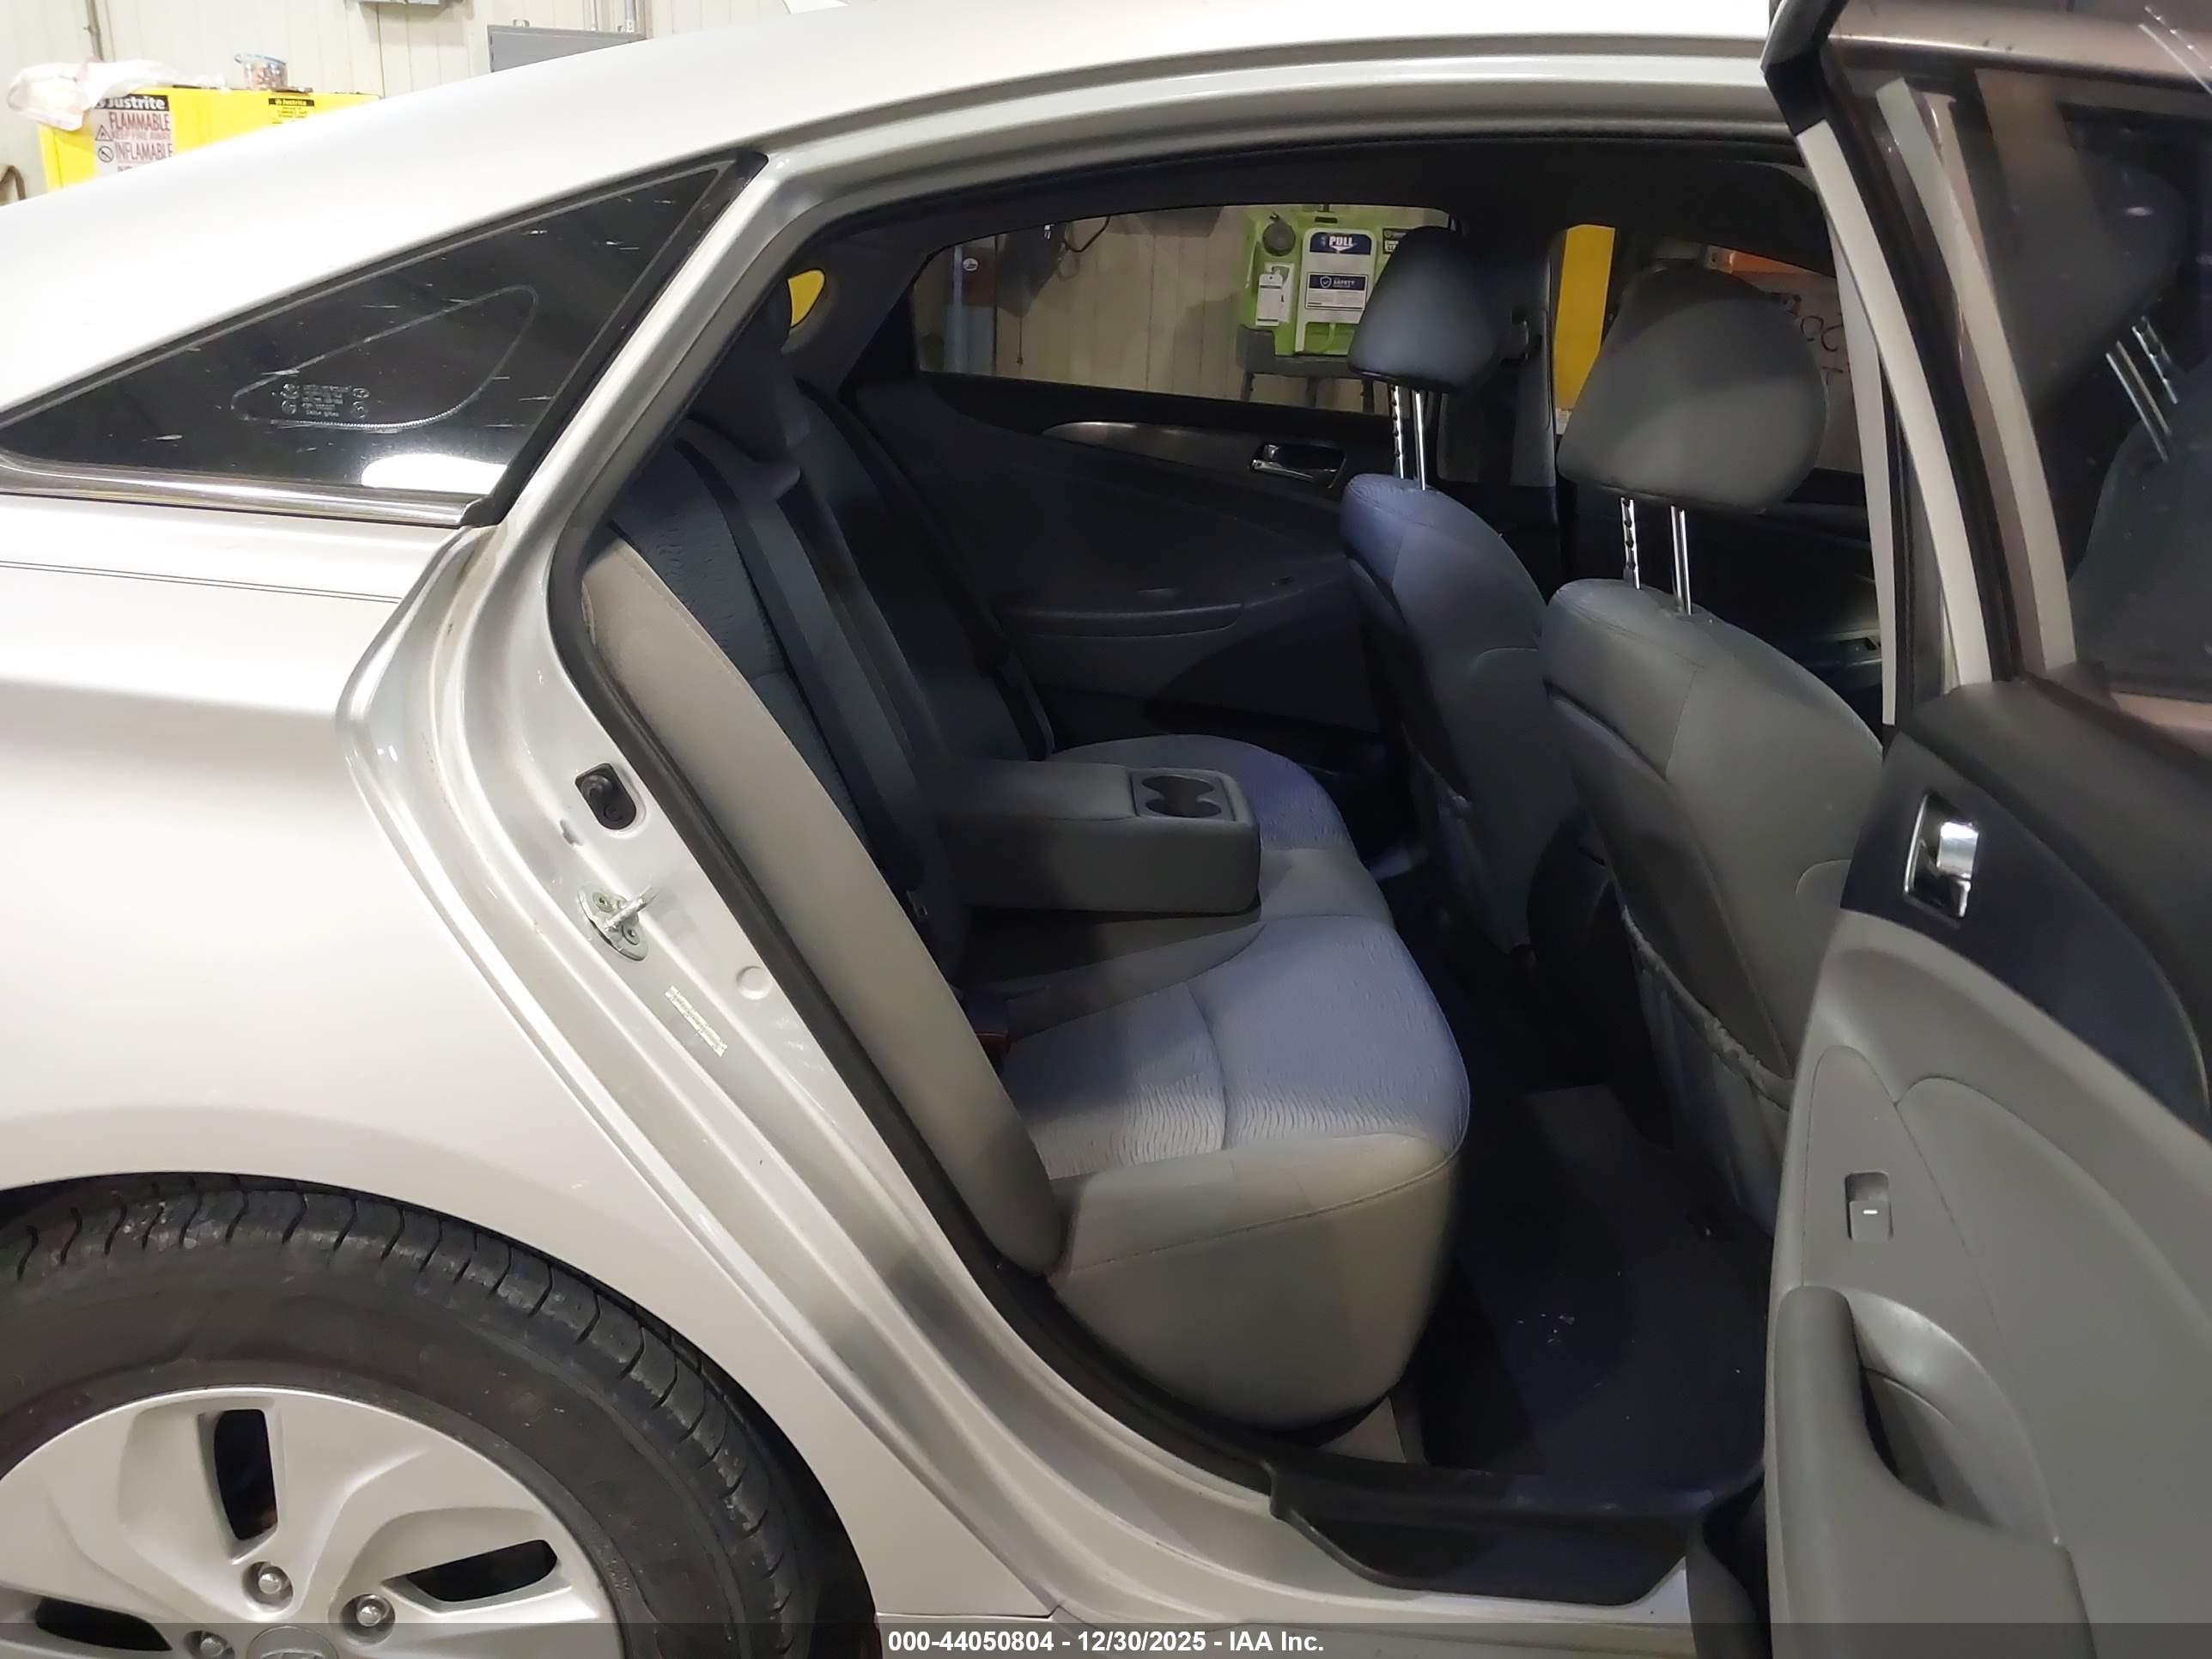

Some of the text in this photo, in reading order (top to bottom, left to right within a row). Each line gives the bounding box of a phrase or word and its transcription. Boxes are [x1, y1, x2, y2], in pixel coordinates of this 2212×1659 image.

[108, 95, 166, 109] Justrite
[108, 111, 171, 131] FLAMMABLE
[1328, 235, 1353, 246] PULL
